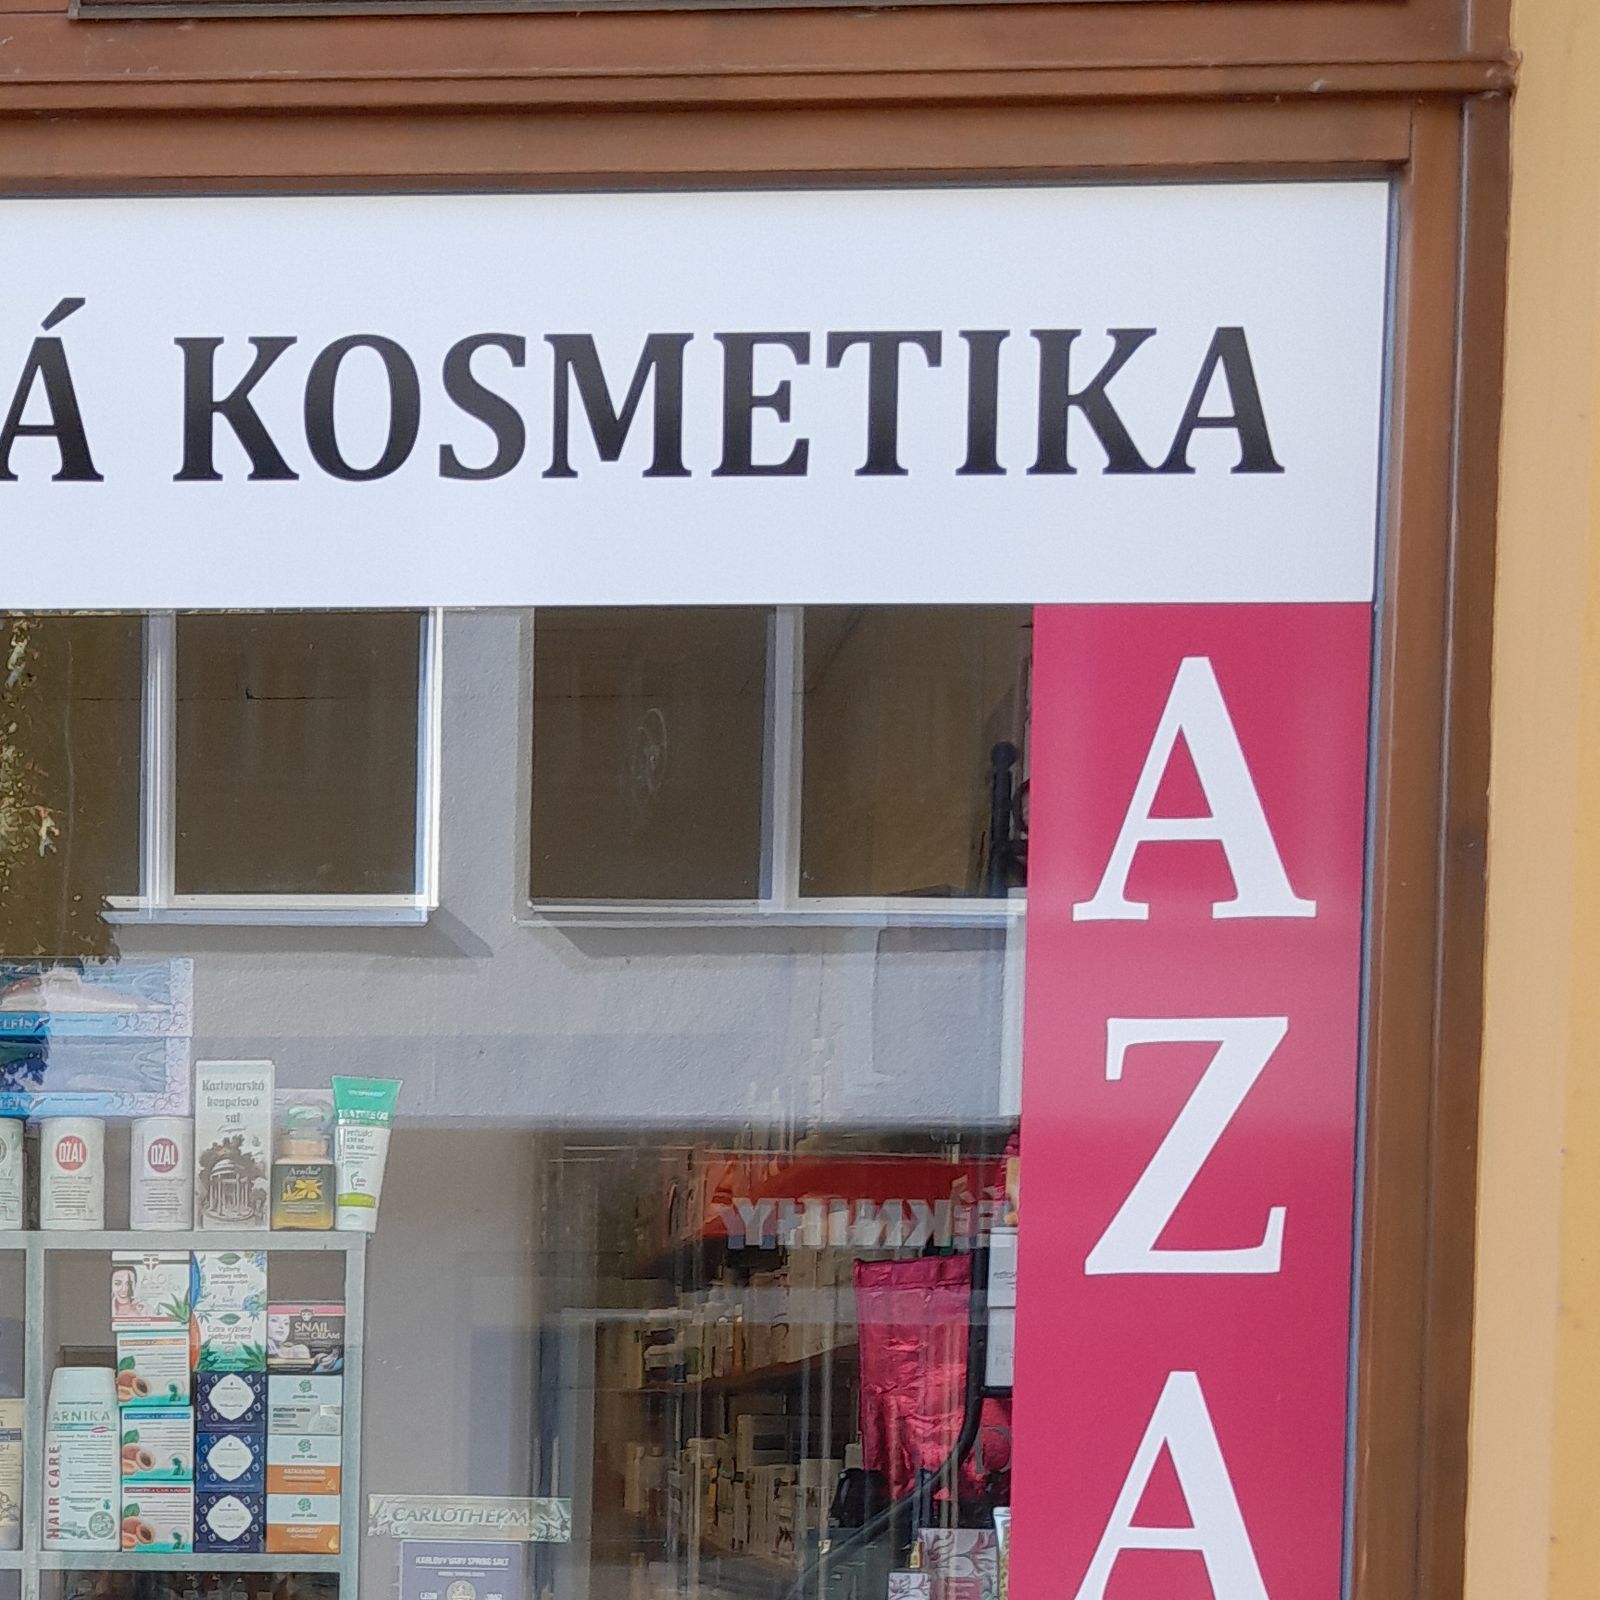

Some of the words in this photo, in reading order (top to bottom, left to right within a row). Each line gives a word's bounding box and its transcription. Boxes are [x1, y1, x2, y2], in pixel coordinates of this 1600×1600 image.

[172, 325, 1287, 482] KOSMETIKA
[294, 1321, 330, 1333] SNAIL
[51, 1409, 111, 1422] ARNIKA
[47, 1444, 61, 1489] CARE
[46, 1494, 60, 1540] HAIR
